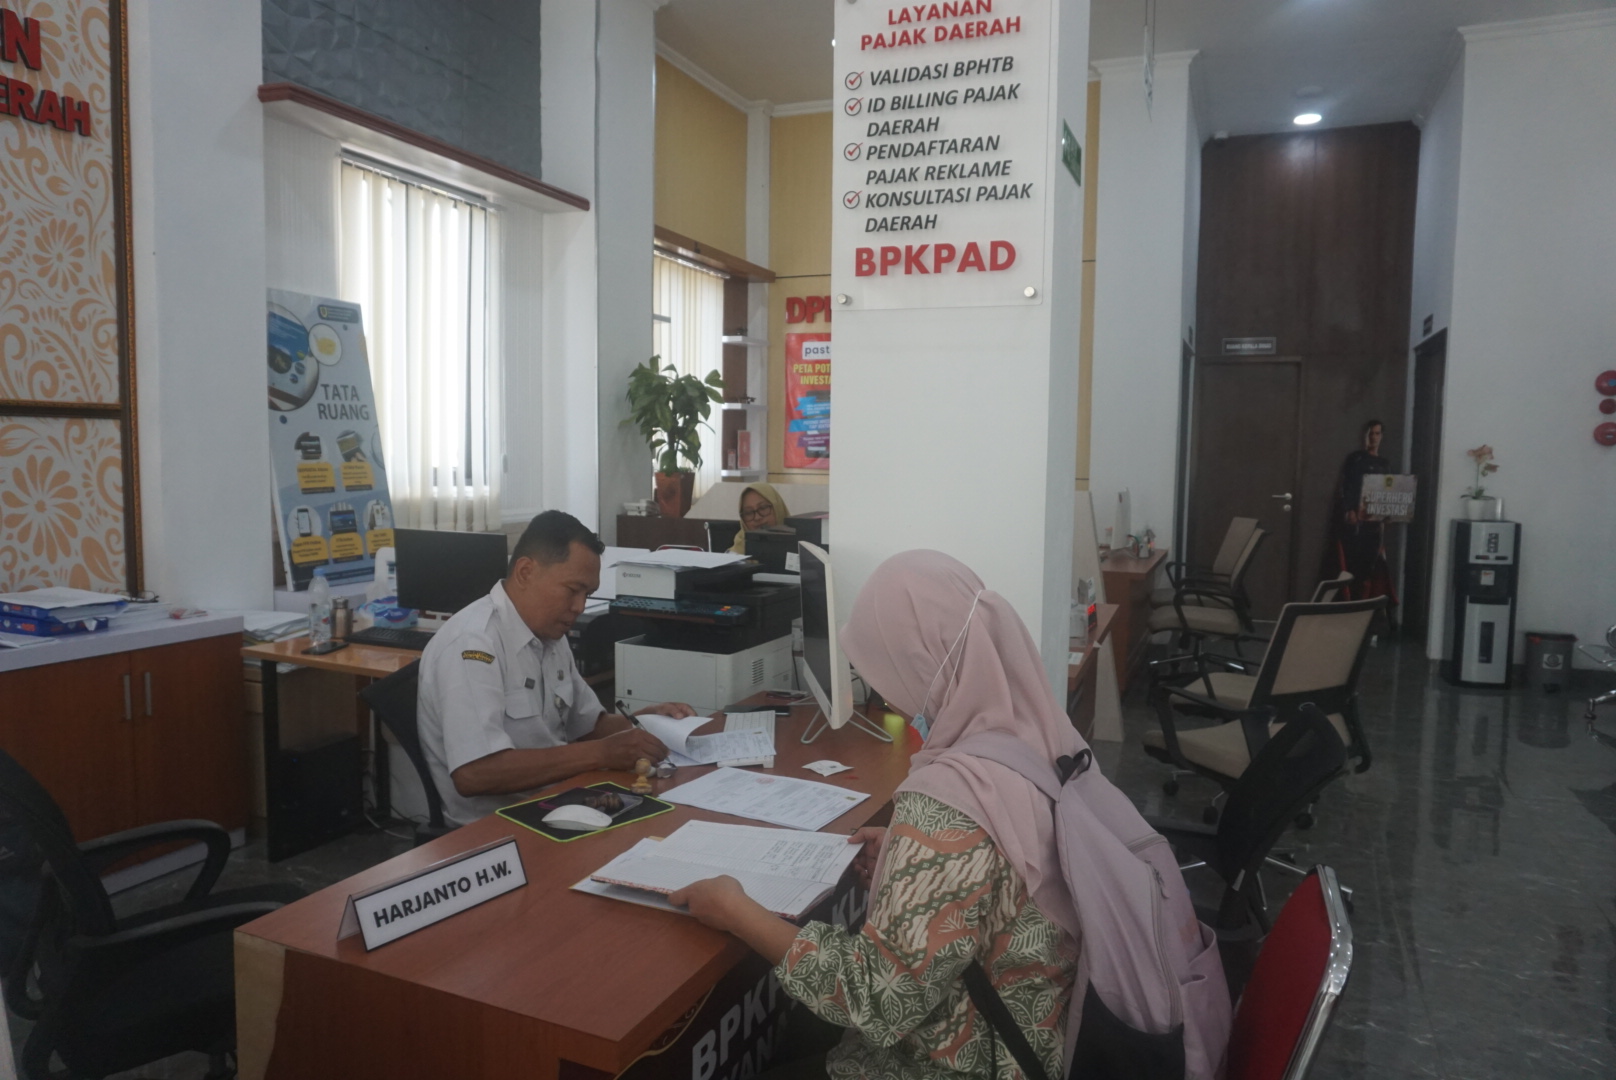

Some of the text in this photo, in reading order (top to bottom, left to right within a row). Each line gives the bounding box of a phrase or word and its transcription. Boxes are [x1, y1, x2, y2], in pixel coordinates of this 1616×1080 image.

[888, 0, 992, 25] LAYANAN
[861, 16, 1021, 50] PAJAK DAERAH
[870, 56, 1014, 86] VALIDASI BPHTB
[867, 83, 1021, 113] ID BILLING PAJAK
[866, 116, 940, 137] DAERAH
[866, 135, 1000, 160] PENDAFTARAN
[865, 160, 1013, 185] PAJAK REKLAME
[865, 183, 1033, 208] KONSULTASI PAJAK
[865, 214, 938, 232] DAERAH
[855, 240, 1016, 277] BPKPAD
[793, 364, 813, 374] PETA
[321, 383, 360, 401] TATA
[317, 403, 369, 421] RUANG
[1365, 491, 1414, 504] SUPERHERO
[1367, 503, 1409, 516] INVESTASI
[373, 861, 512, 928] HARJANTO H.W.
